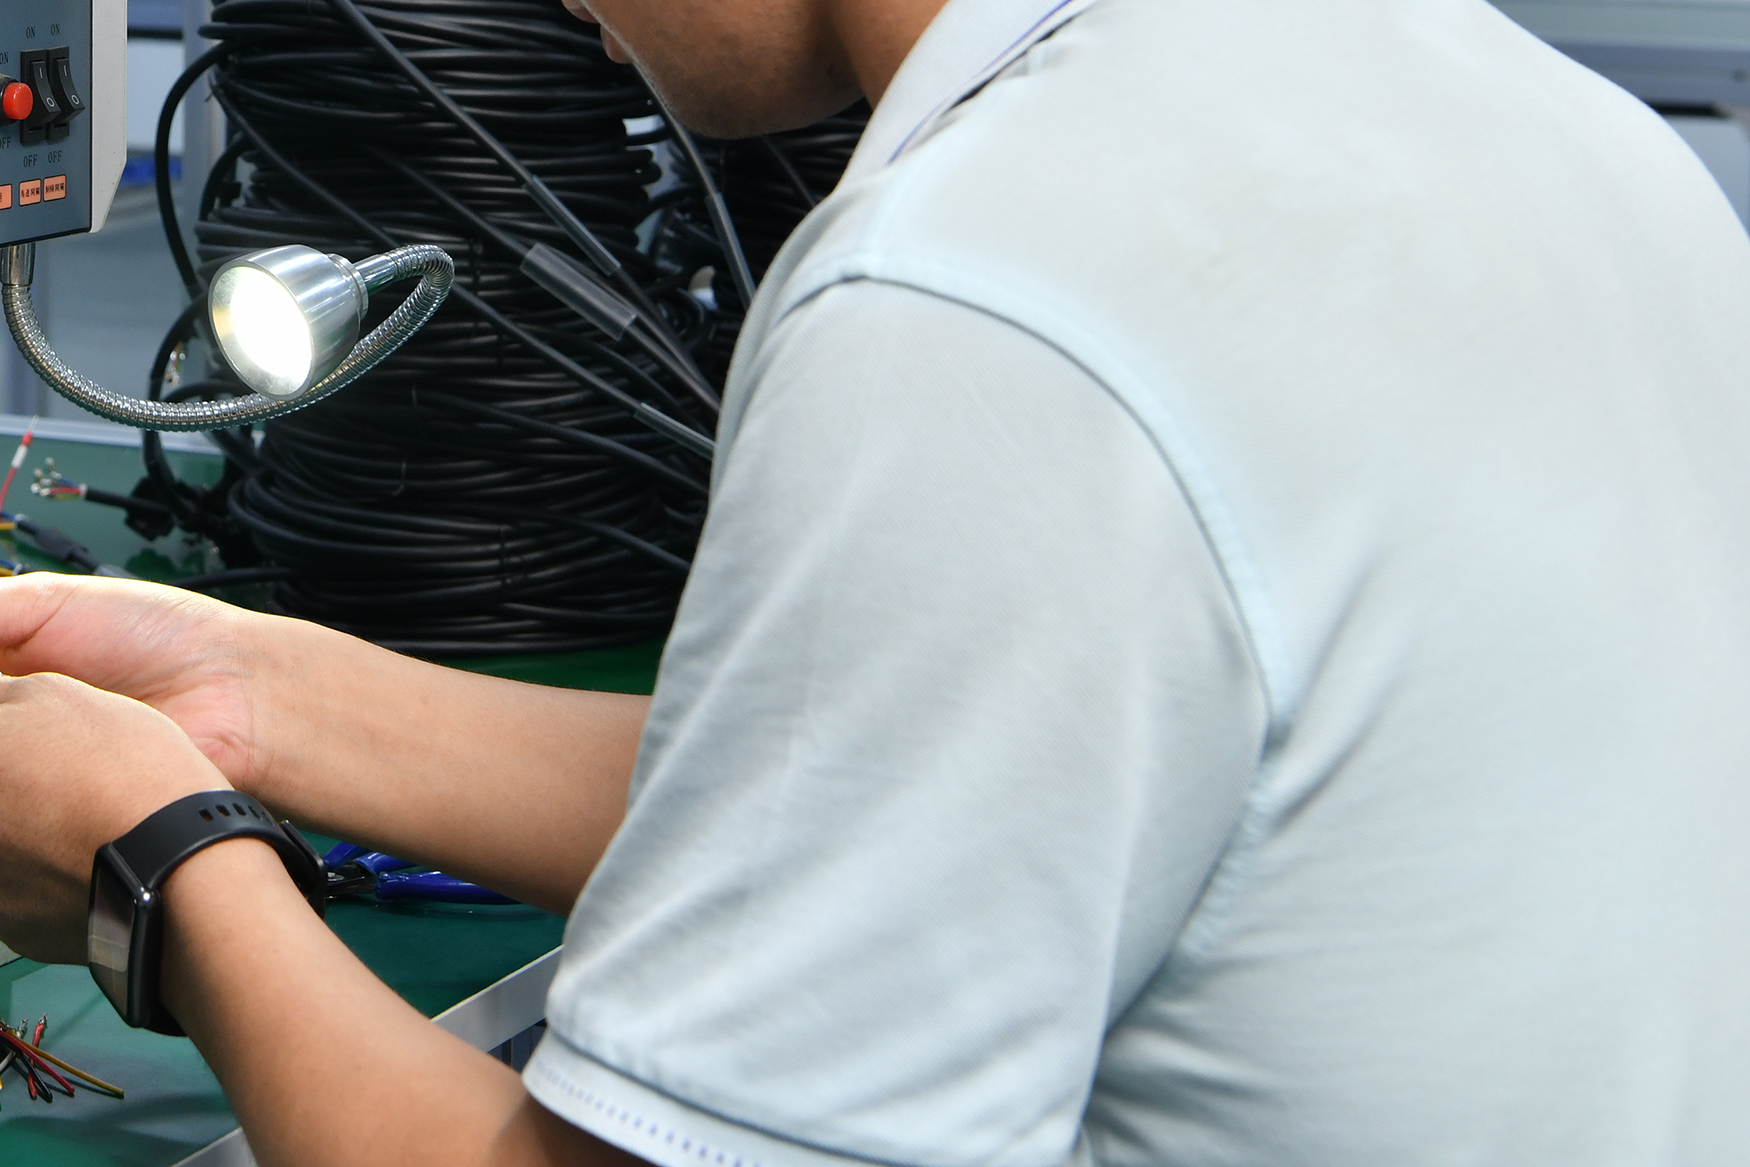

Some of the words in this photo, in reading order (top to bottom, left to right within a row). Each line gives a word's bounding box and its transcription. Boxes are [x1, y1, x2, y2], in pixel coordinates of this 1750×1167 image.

[25, 26, 36, 39] ON
[50, 23, 61, 36] ON
[23, 154, 38, 168] OFF
[47, 150, 63, 164] OFF
